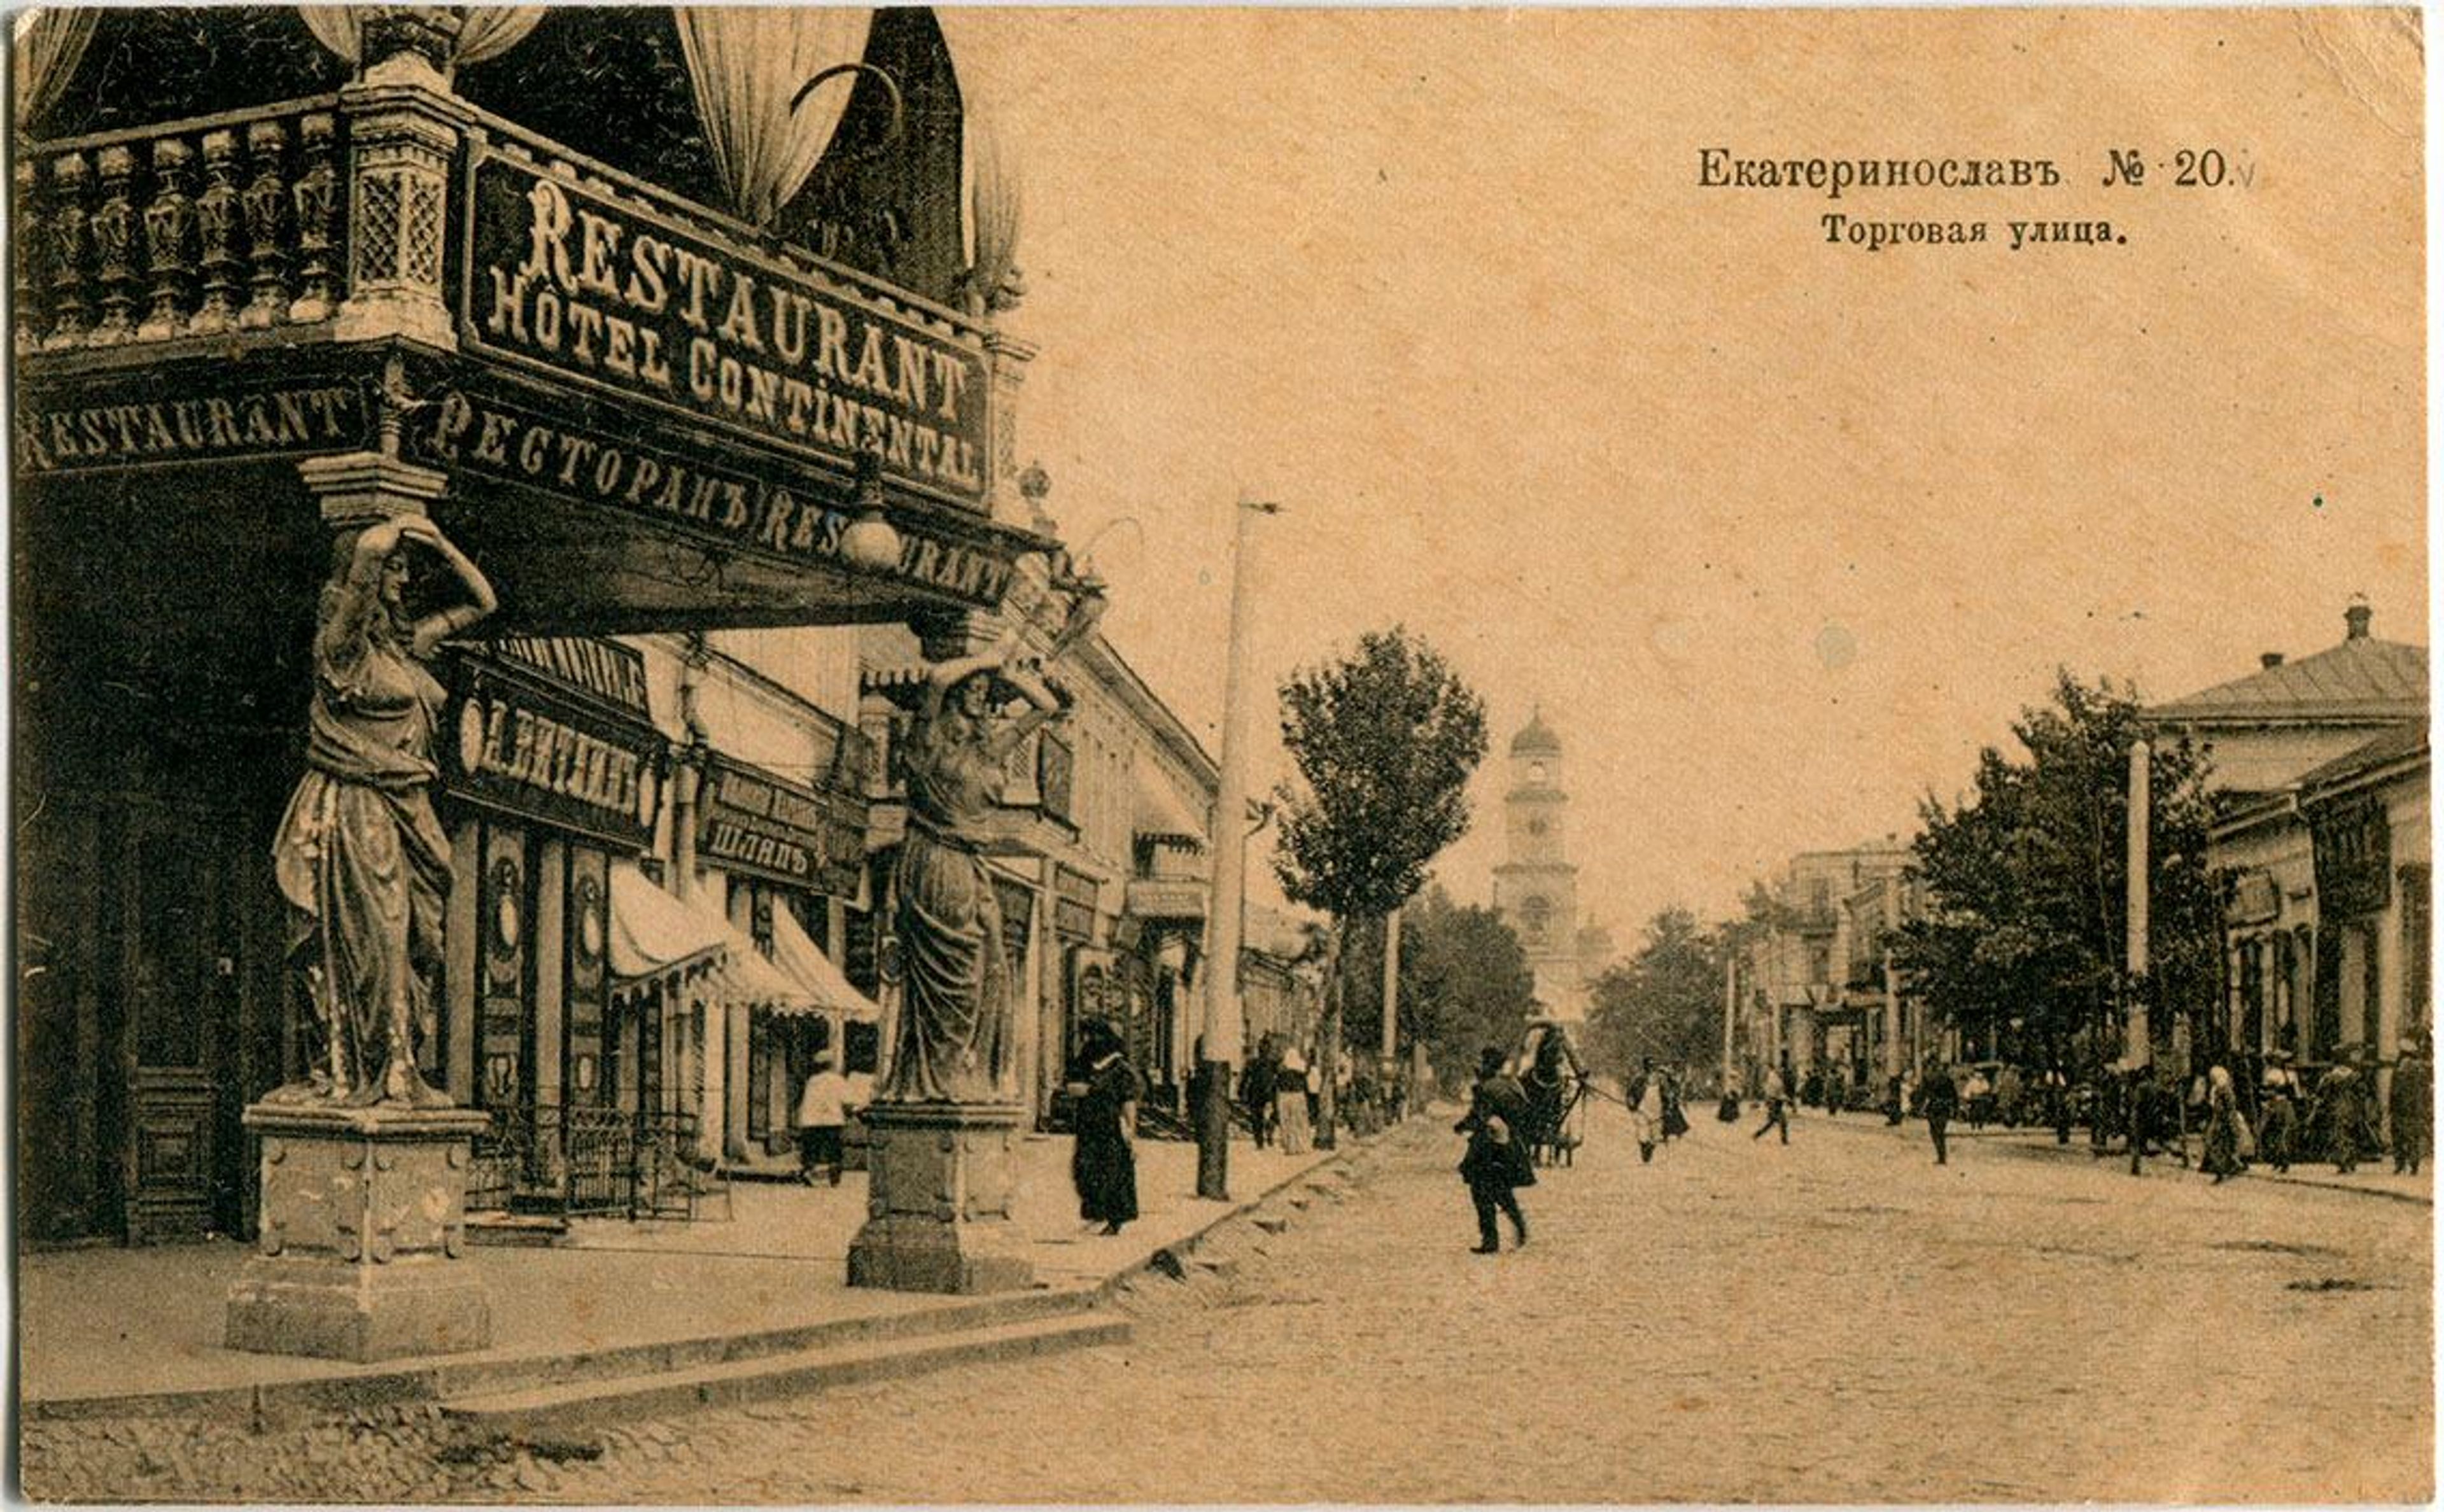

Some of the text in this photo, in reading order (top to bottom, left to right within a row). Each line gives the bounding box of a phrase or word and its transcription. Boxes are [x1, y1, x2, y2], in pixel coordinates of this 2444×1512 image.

[488, 265, 671, 388] HÔTEL
[519, 179, 967, 421] RESTAURANT
[429, 390, 748, 528] РЕСТОРАНЪ
[757, 490, 1012, 599] RESURANT
